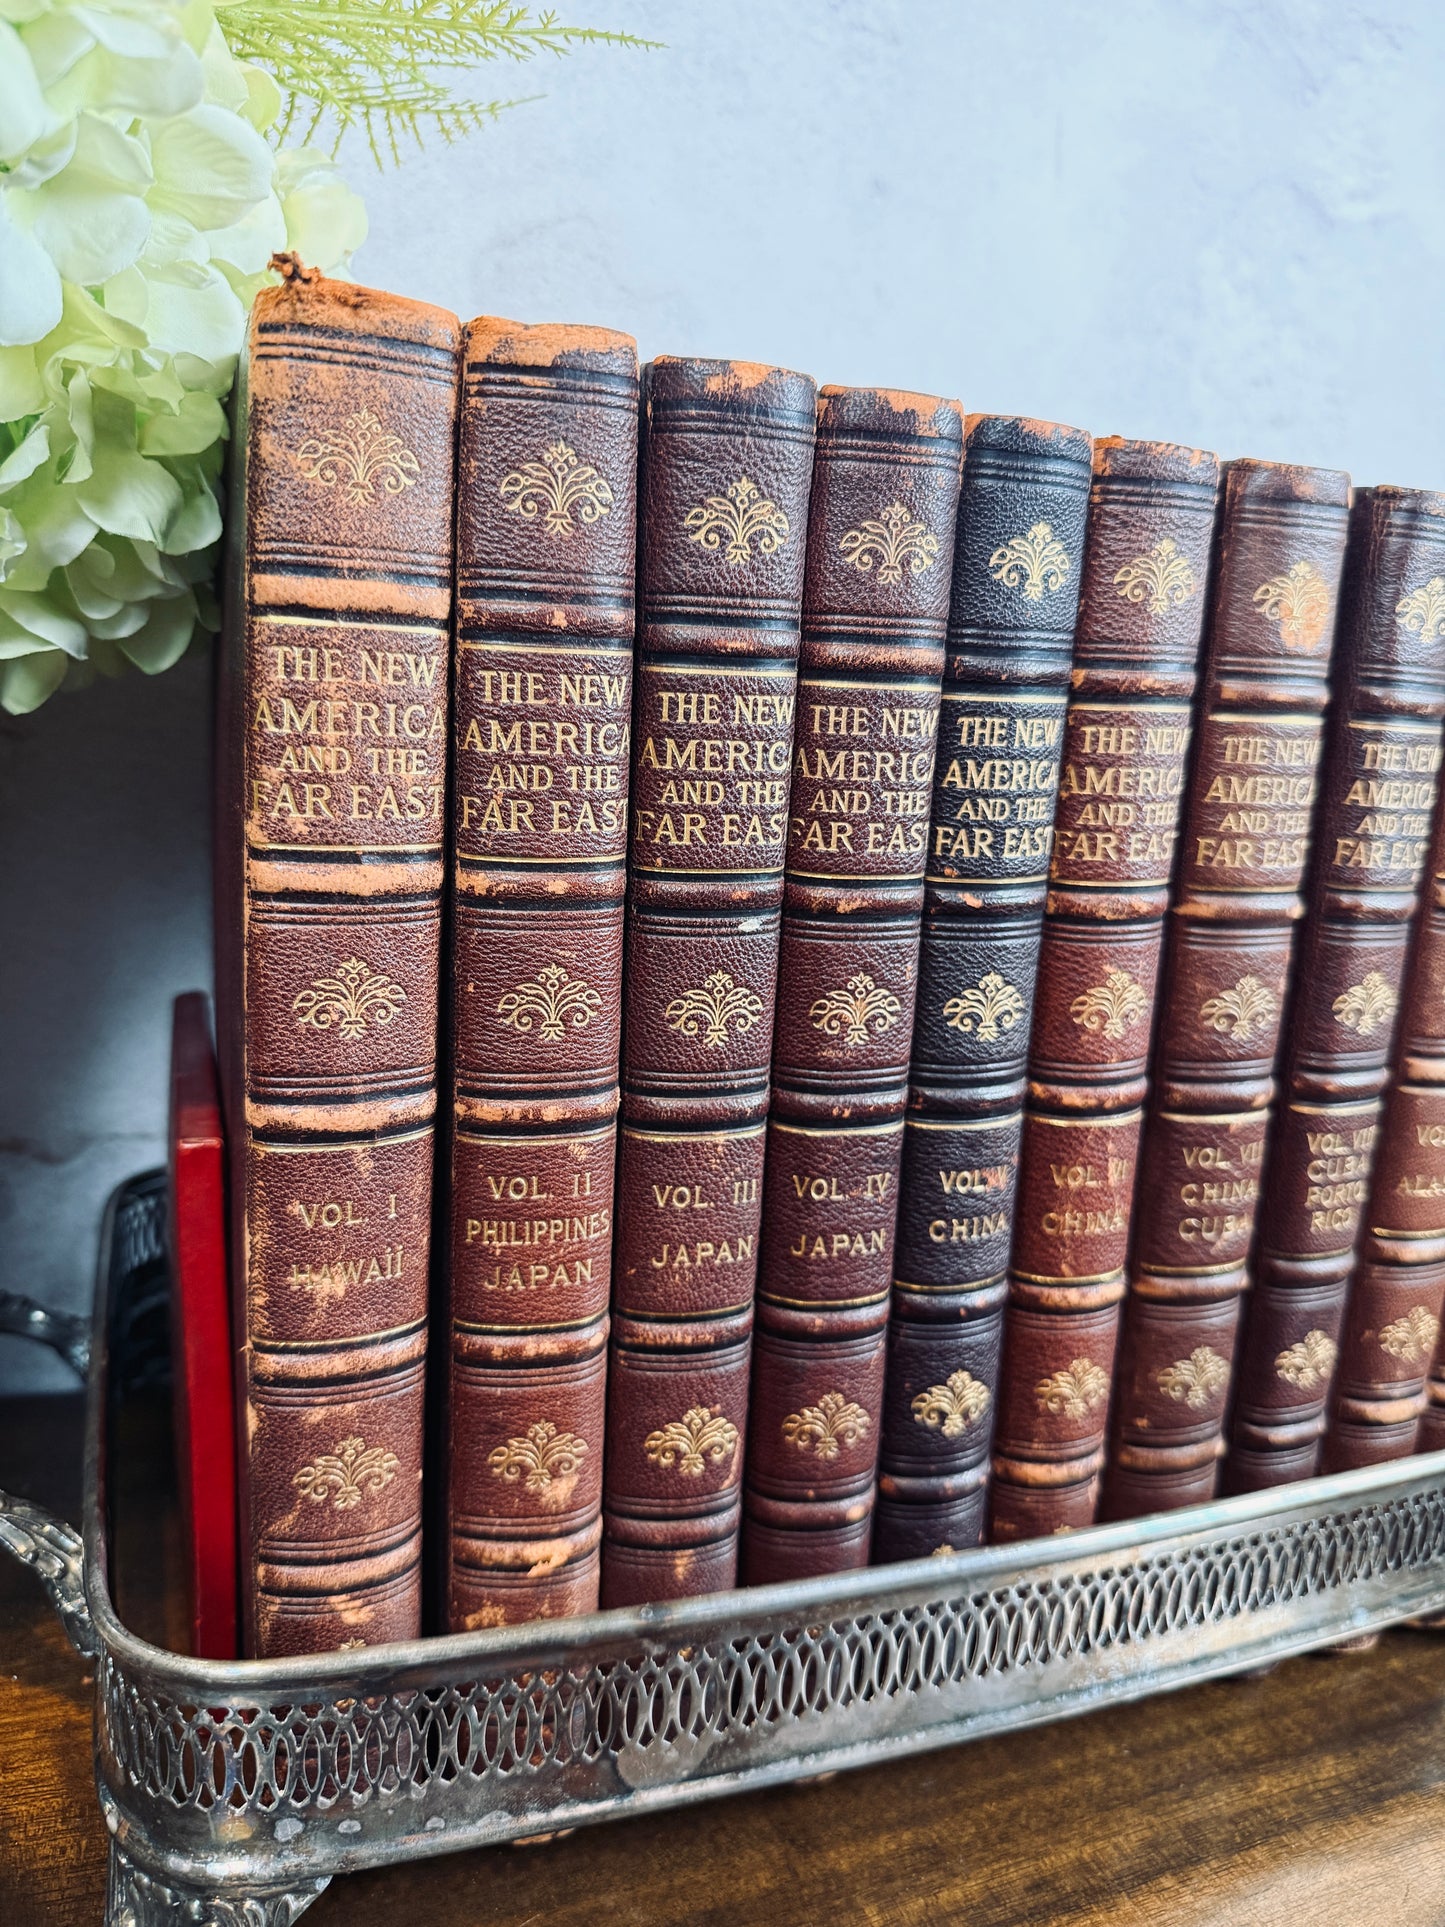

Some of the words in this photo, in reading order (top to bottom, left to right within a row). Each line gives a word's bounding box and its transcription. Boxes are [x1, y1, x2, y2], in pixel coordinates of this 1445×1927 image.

[275, 645, 343, 682] THE
[361, 652, 441, 687] NEW
[479, 670, 546, 705] THE
[560, 674, 627, 707] NEW
[254, 699, 446, 738] AMERICA
[659, 692, 720, 724] THE
[734, 695, 794, 725] NEW
[810, 705, 869, 735] THE
[882, 708, 940, 737] NEW
[957, 716, 1009, 747] THE
[1014, 718, 1061, 748] NEW
[1080, 725, 1135, 754] THE
[1144, 727, 1193, 755] NEW
[278, 745, 351, 774] AND
[365, 748, 428, 775] THE
[639, 737, 791, 771] AMERIC
[1221, 737, 1268, 764] THE
[1276, 740, 1320, 765] NEW
[1362, 741, 1404, 771] THE
[488, 765, 553, 790] AND
[565, 766, 619, 791] THE
[660, 780, 725, 805] AND
[738, 781, 785, 806] THE
[253, 780, 334, 817] FAR
[352, 785, 443, 819] EAST
[807, 790, 871, 814] AND
[881, 791, 927, 815] THE
[956, 798, 1010, 821] AND
[1015, 798, 1048, 820] THE
[1076, 803, 1136, 826] AND
[1143, 802, 1178, 825] THE
[461, 799, 537, 832] FAR
[636, 810, 707, 846] FAR
[722, 815, 788, 846] EAS
[1219, 811, 1268, 833] AND
[1275, 811, 1308, 834] THE
[1356, 814, 1398, 835] AND
[1401, 814, 1431, 836] THE
[935, 826, 994, 859] FAR
[1054, 831, 1119, 861] FAR
[1194, 837, 1254, 868] FAR
[1332, 837, 1384, 868] FAR
[1389, 840, 1428, 869] EAS
[572, 1172, 591, 1197] II
[734, 1179, 757, 1205] III
[865, 1172, 892, 1199] IV
[1180, 1180, 1258, 1208] CHINA
[388, 1194, 400, 1218] I
[1310, 1206, 1357, 1235] RICO
[467, 1209, 610, 1246] PHILIPPINES
[929, 1211, 1008, 1243] CHINA
[1042, 1208, 1125, 1236] CHINA
[652, 1235, 754, 1269] JAPAN
[791, 1228, 886, 1258] JAPAN
[291, 1246, 403, 1290] HAWAII
[485, 1259, 594, 1292] JAPAN
